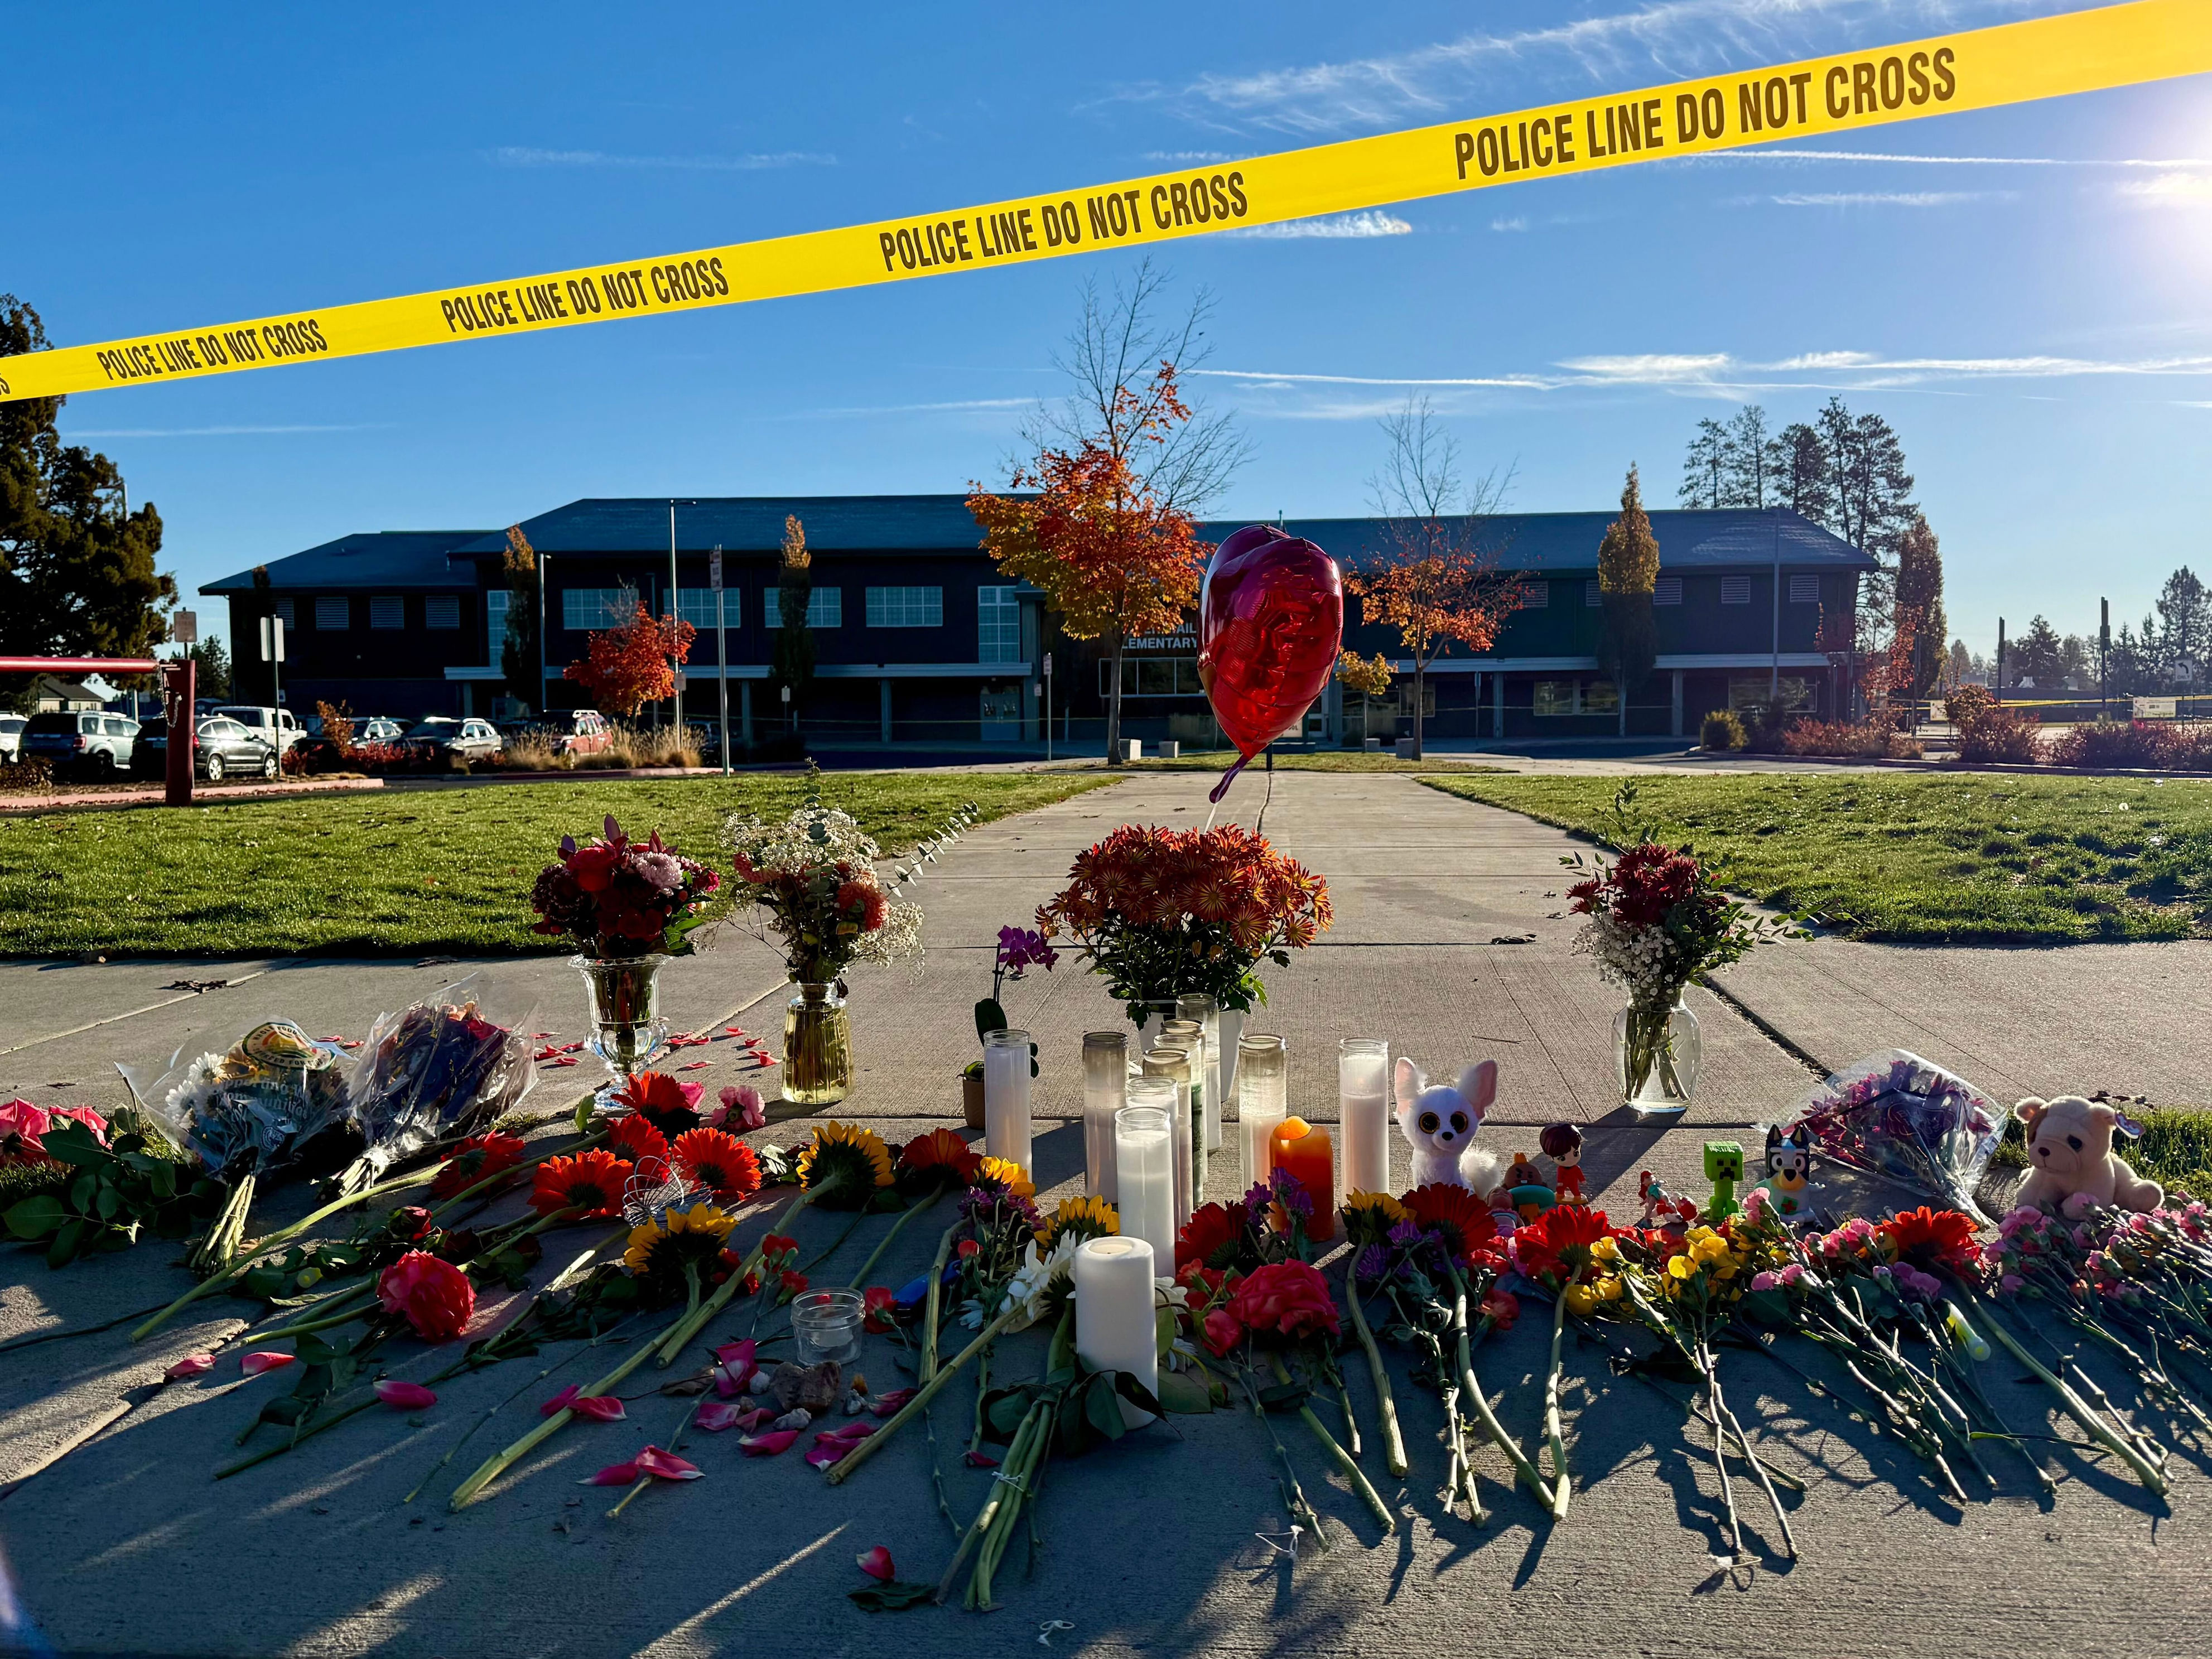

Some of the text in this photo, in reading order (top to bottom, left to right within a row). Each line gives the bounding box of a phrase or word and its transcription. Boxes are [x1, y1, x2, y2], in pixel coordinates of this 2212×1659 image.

[1455, 47, 1955, 180] POLICE LINE DO NOT CROSS
[879, 171, 1247, 272] POLICE LINE DO NOT CROSS
[440, 257, 729, 332] POLICE LINE DO NOT CROSS
[96, 319, 327, 380] POLICE LINE DO NOT CROSS
[1122, 638, 1197, 649] EMENTARY
